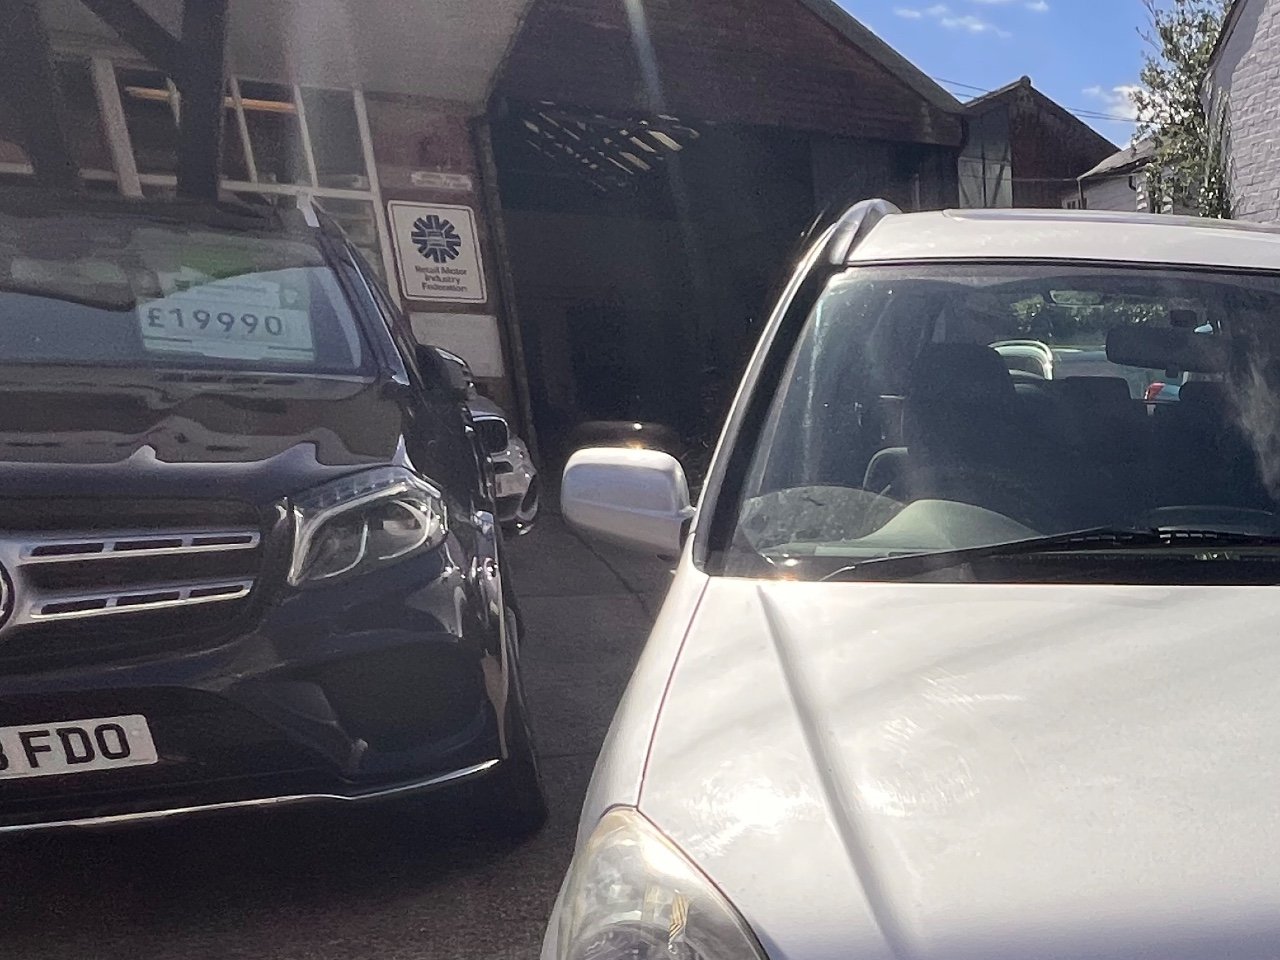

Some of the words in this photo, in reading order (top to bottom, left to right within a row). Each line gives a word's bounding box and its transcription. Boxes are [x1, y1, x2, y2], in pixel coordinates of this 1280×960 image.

[441, 266, 467, 276] Motor
[423, 272, 461, 285] Industry
[421, 282, 468, 293] Federation
[148, 307, 283, 337] £19990
[18, 723, 131, 768] FDO
